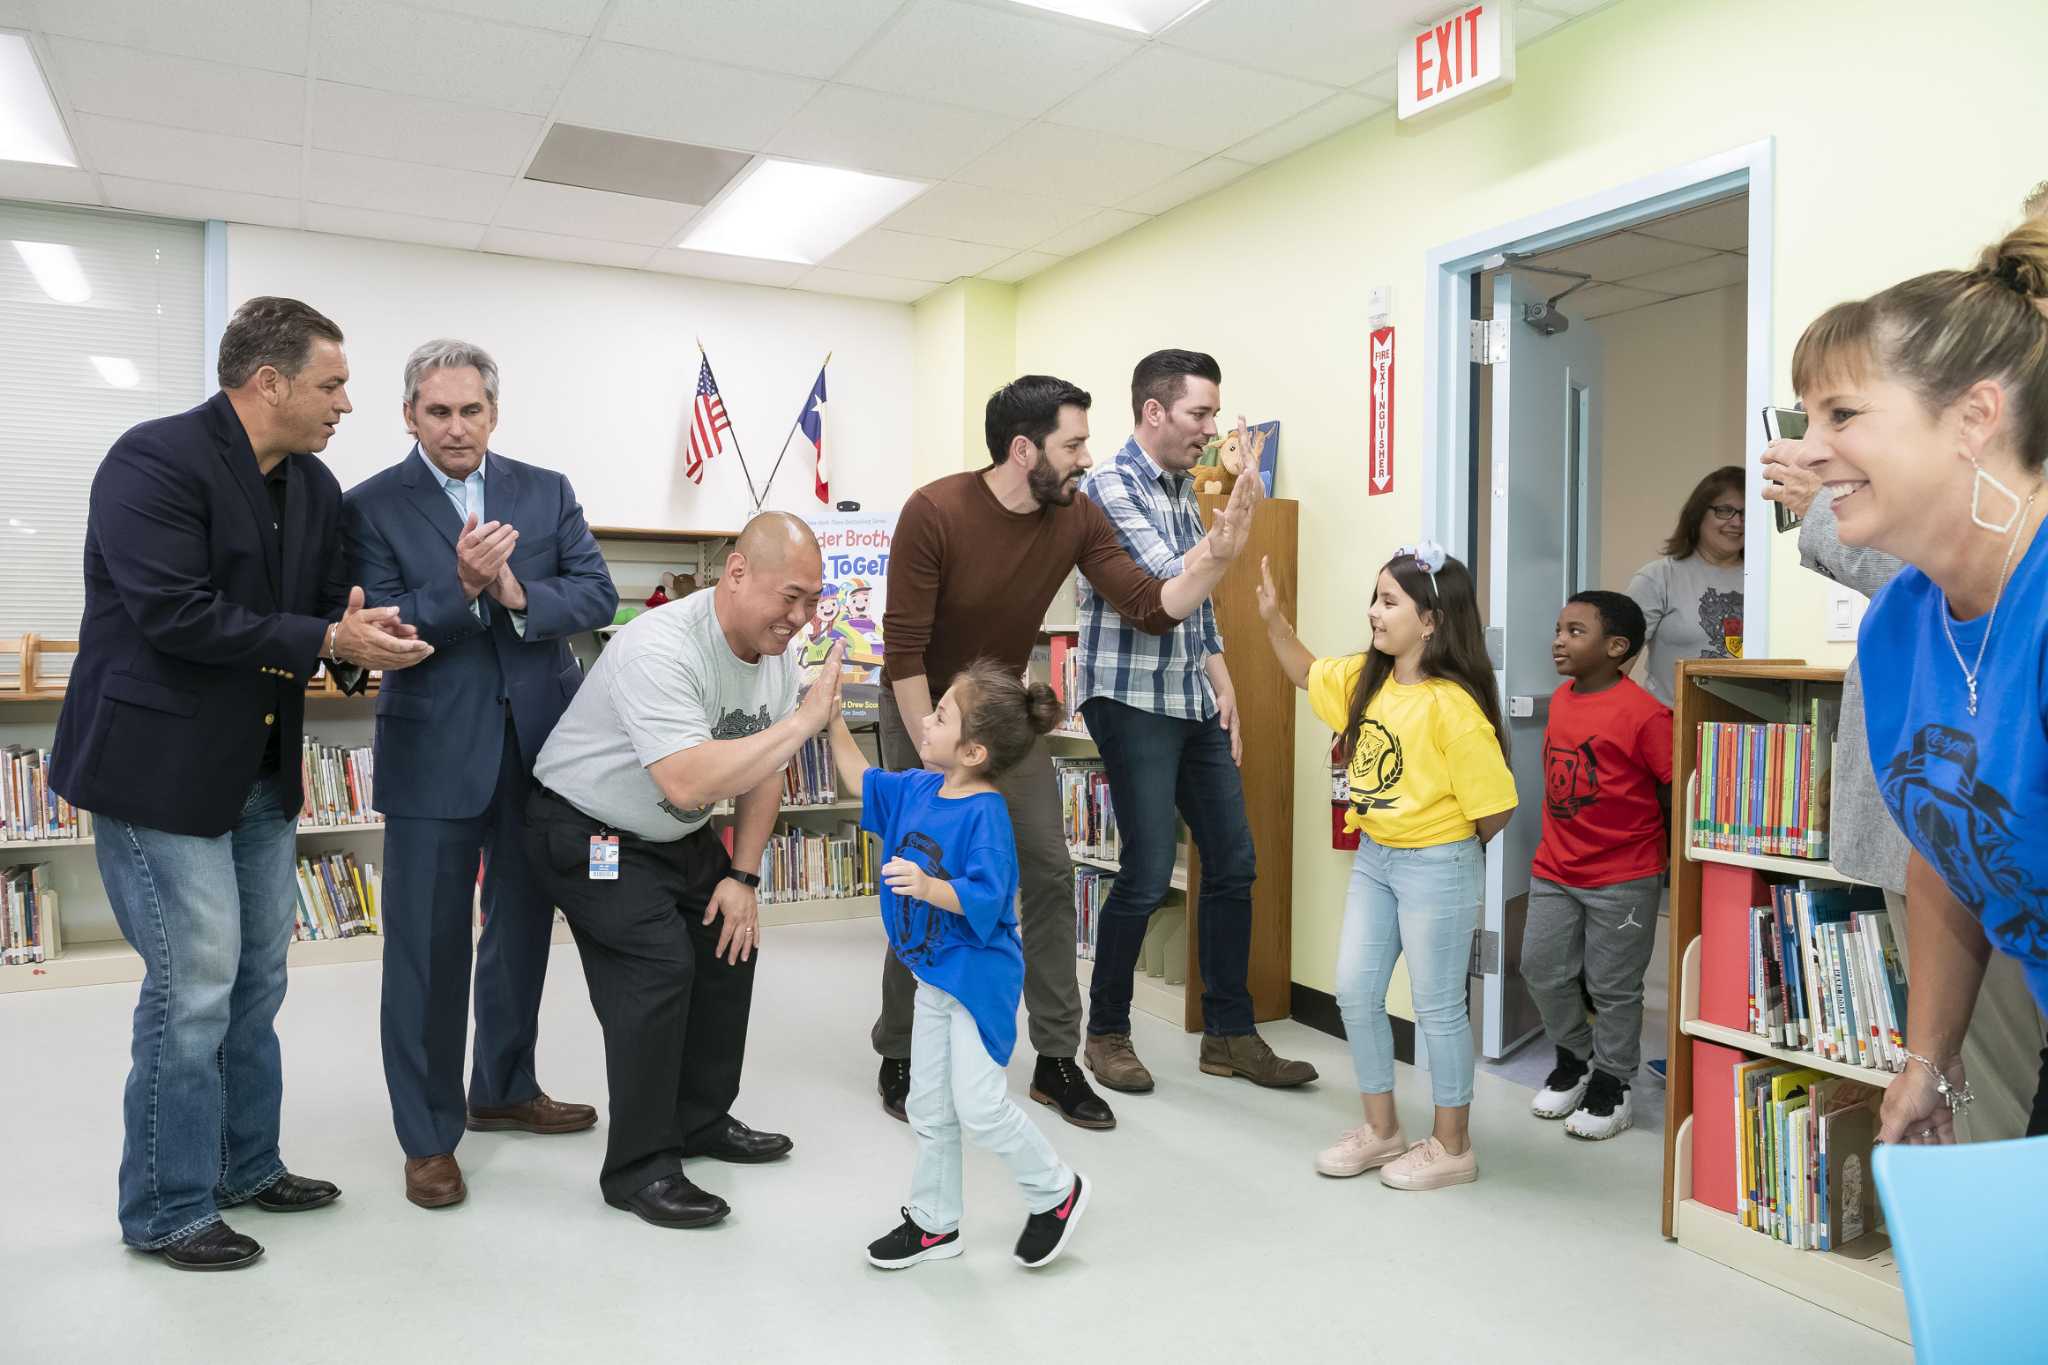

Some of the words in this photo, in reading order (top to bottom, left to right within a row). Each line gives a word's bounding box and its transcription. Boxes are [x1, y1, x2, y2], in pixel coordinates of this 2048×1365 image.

[1415, 5, 1483, 102] EXIT
[1375, 349, 1390, 362] FIRE
[1378, 362, 1386, 479] EXTINGUISHER
[828, 554, 889, 579] ToGeT
